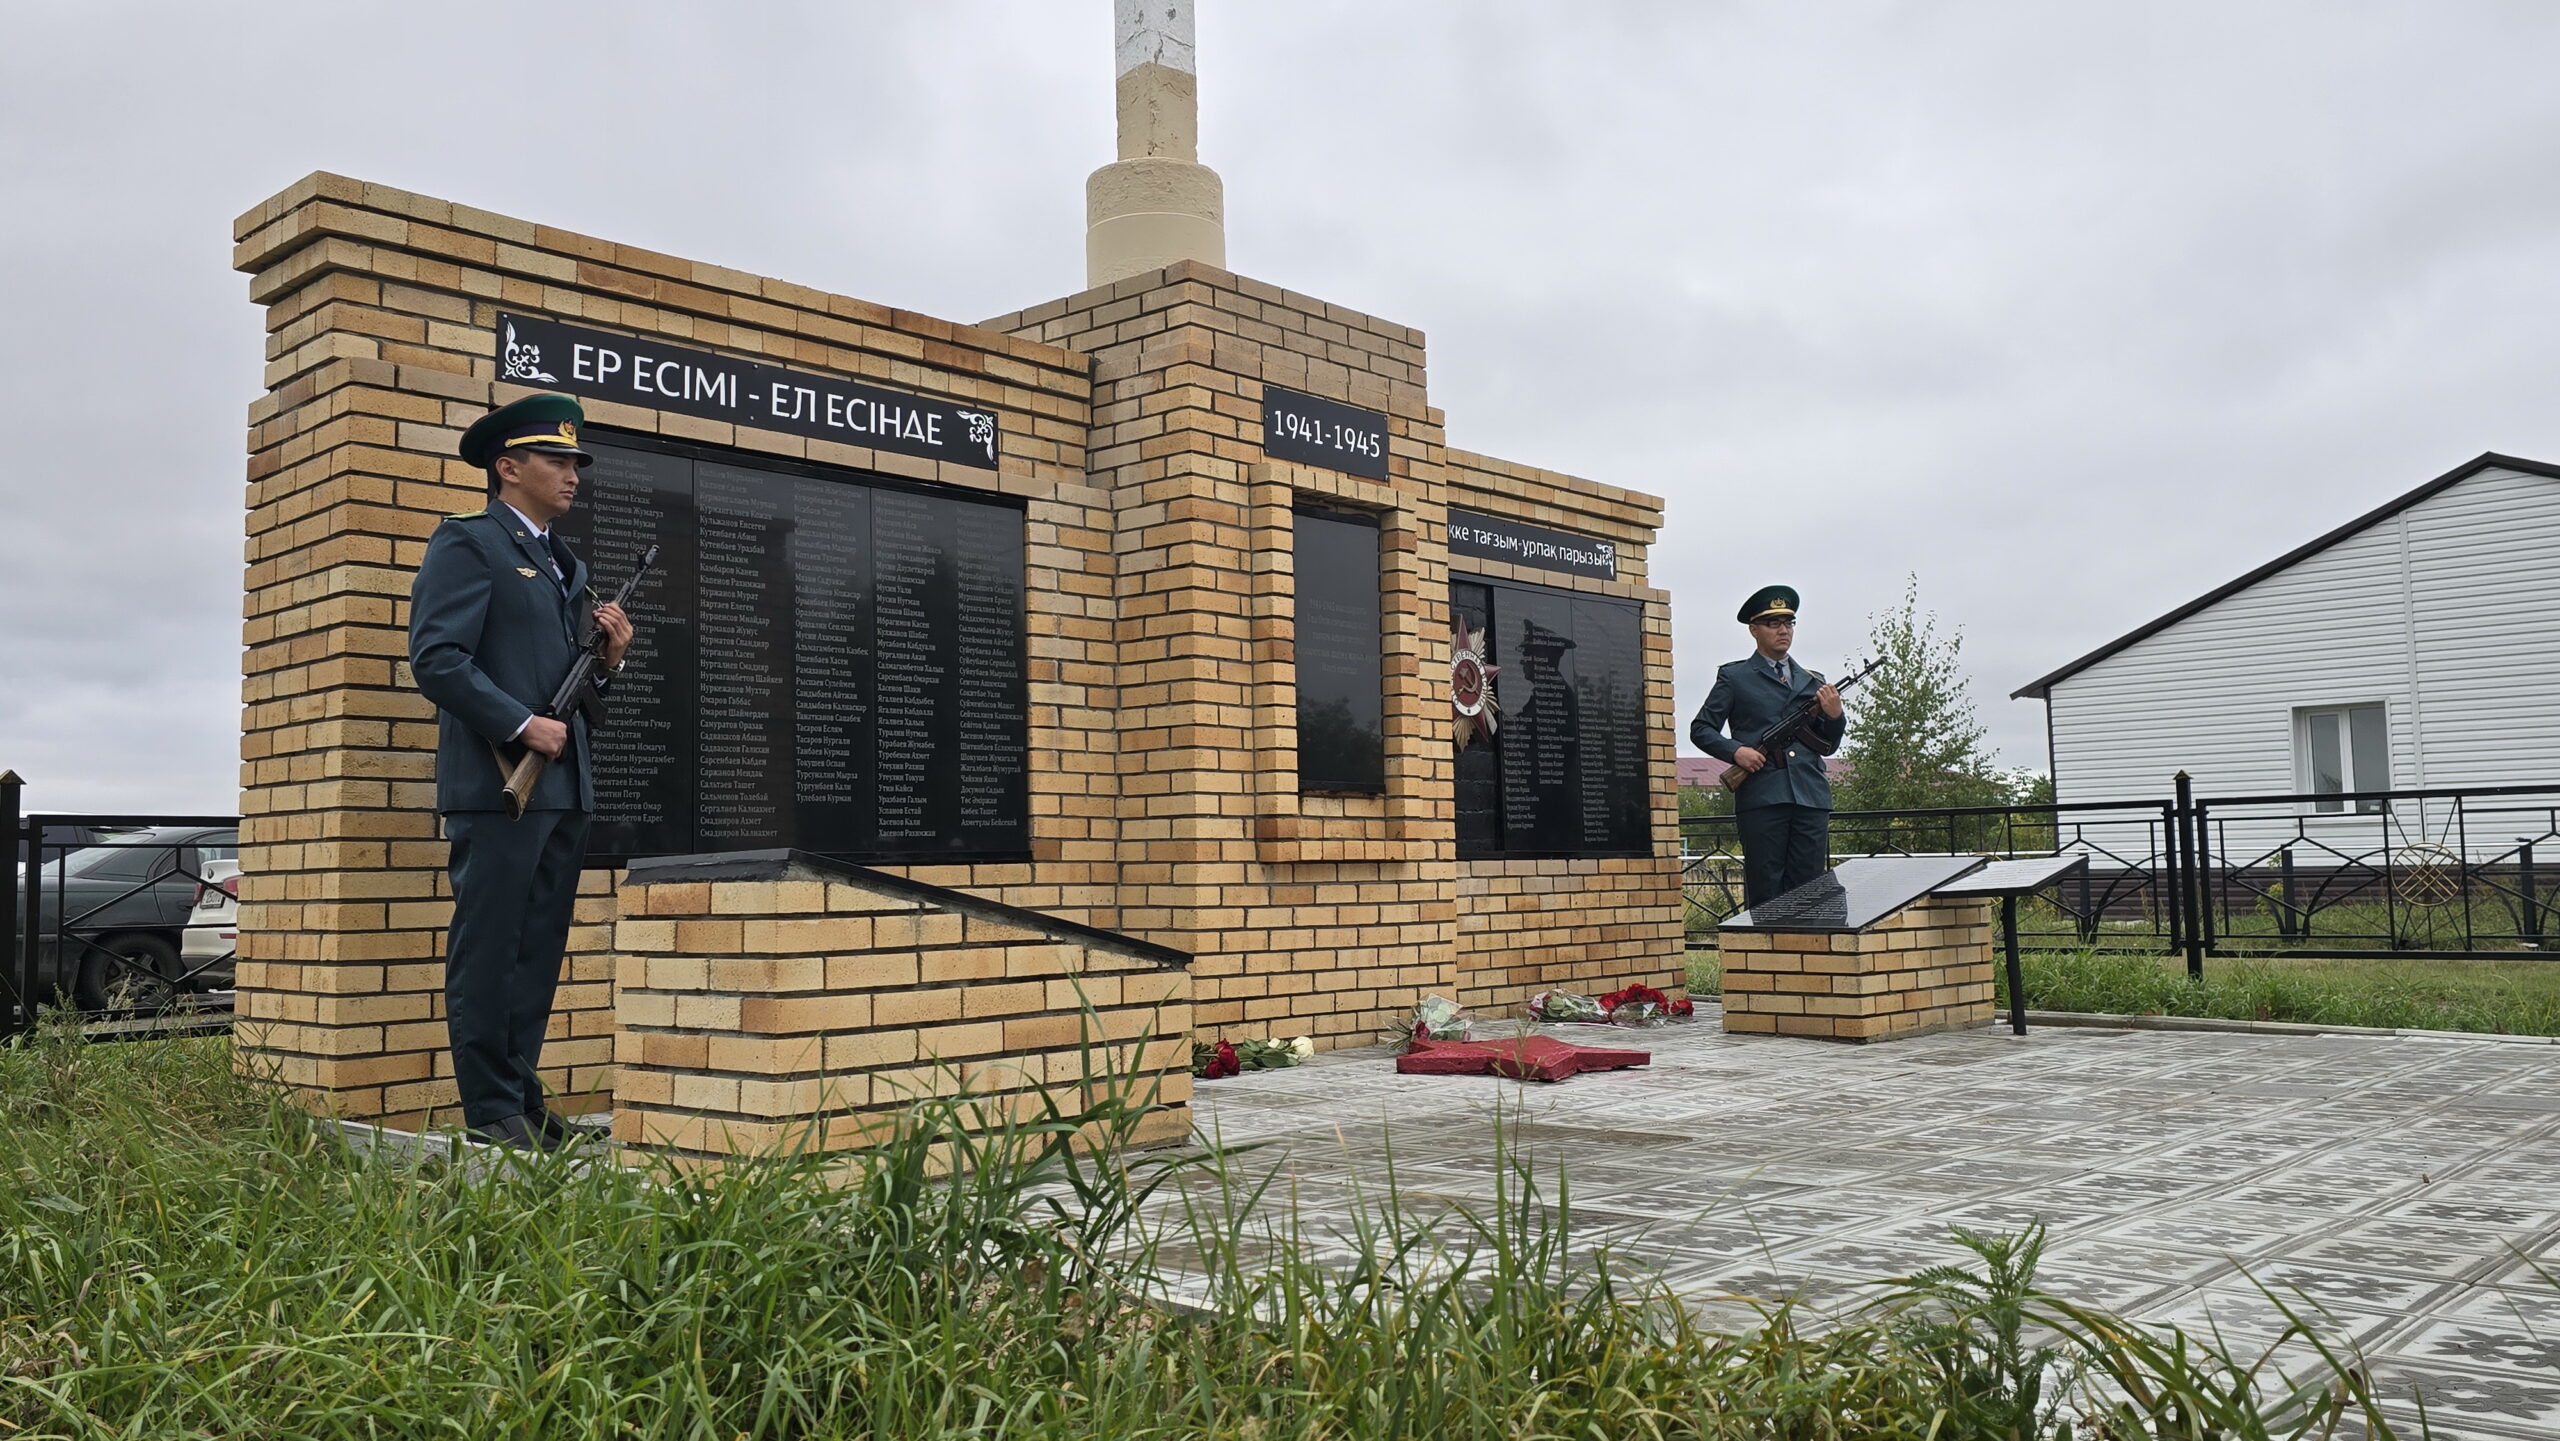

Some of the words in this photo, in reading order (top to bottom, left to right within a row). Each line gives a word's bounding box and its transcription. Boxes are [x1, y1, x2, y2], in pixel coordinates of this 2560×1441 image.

[573, 343, 622, 384] ЕР
[633, 355, 737, 408] ЕСІМІ
[771, 382, 816, 423] ЕЛ
[827, 393, 943, 446] ЕСІНДЕ
[1274, 410, 1381, 458] 1941-1945
[592, 501, 632, 514] Арыстанов
[592, 513, 632, 525] Арыстанов
[736, 589, 758, 601] Мурат
[700, 670, 754, 682] Нурмагамбетов
[627, 682, 653, 694] Мухтар
[699, 694, 727, 706] Омаров
[699, 707, 727, 718] Омаров
[622, 789, 641, 800] Петр
[642, 801, 662, 812] Омар
